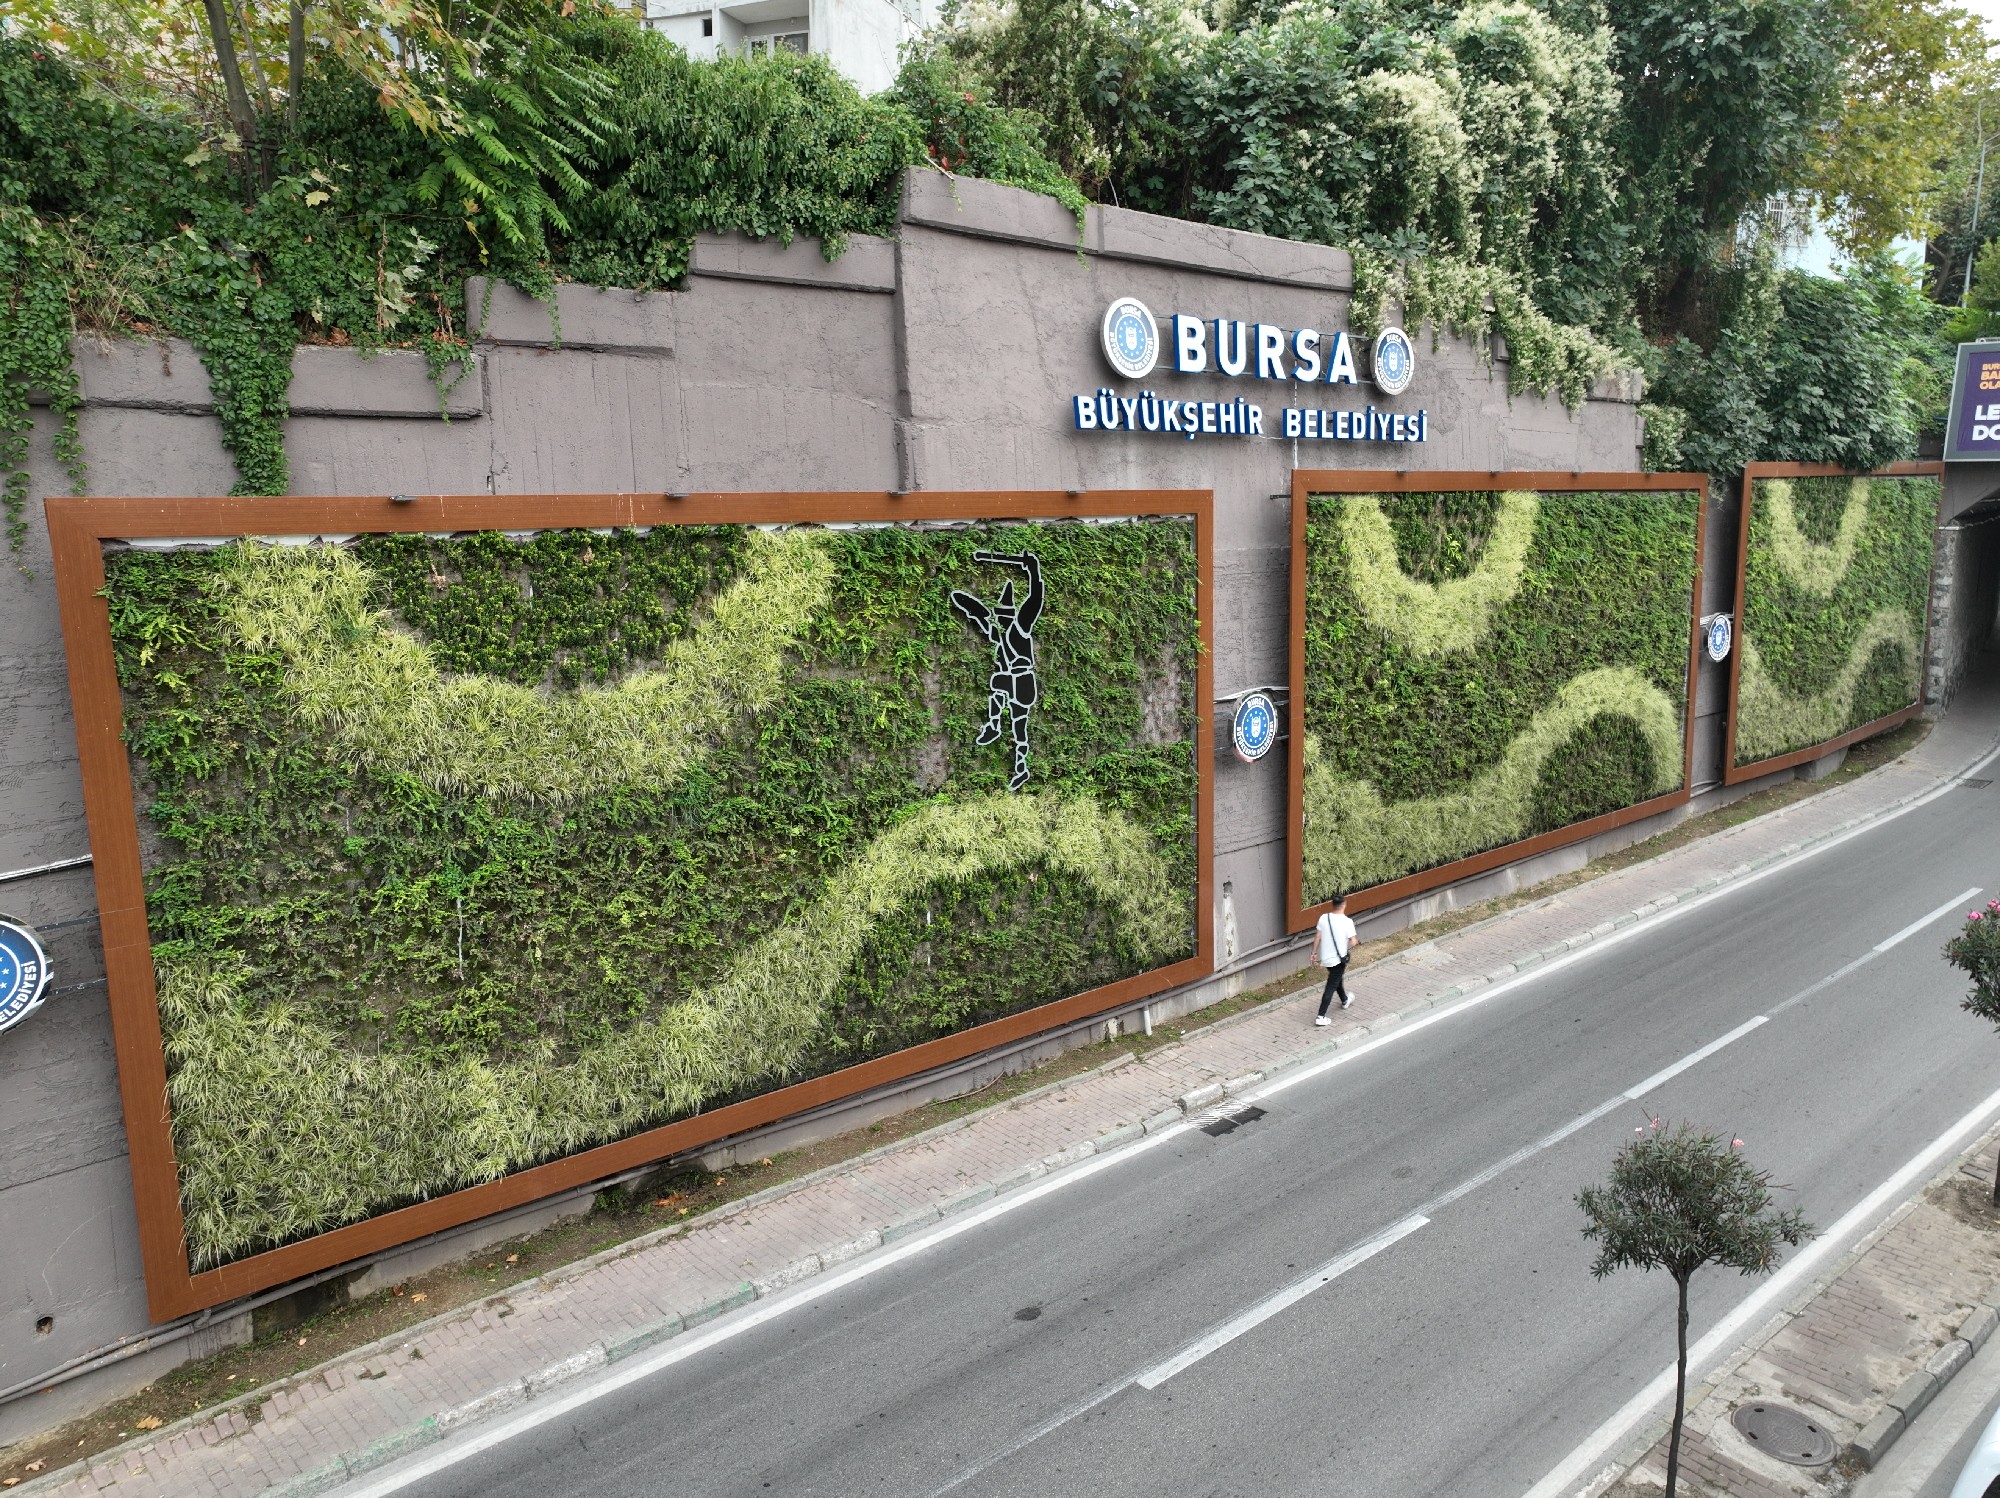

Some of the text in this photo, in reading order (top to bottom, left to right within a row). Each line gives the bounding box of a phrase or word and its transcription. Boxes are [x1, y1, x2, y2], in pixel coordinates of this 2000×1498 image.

[1172, 313, 1357, 385] BURSA
[1981, 371, 2000, 381] BA
[1073, 388, 1427, 442] BÜYÜKŞEHİR BELEDİYESİ
